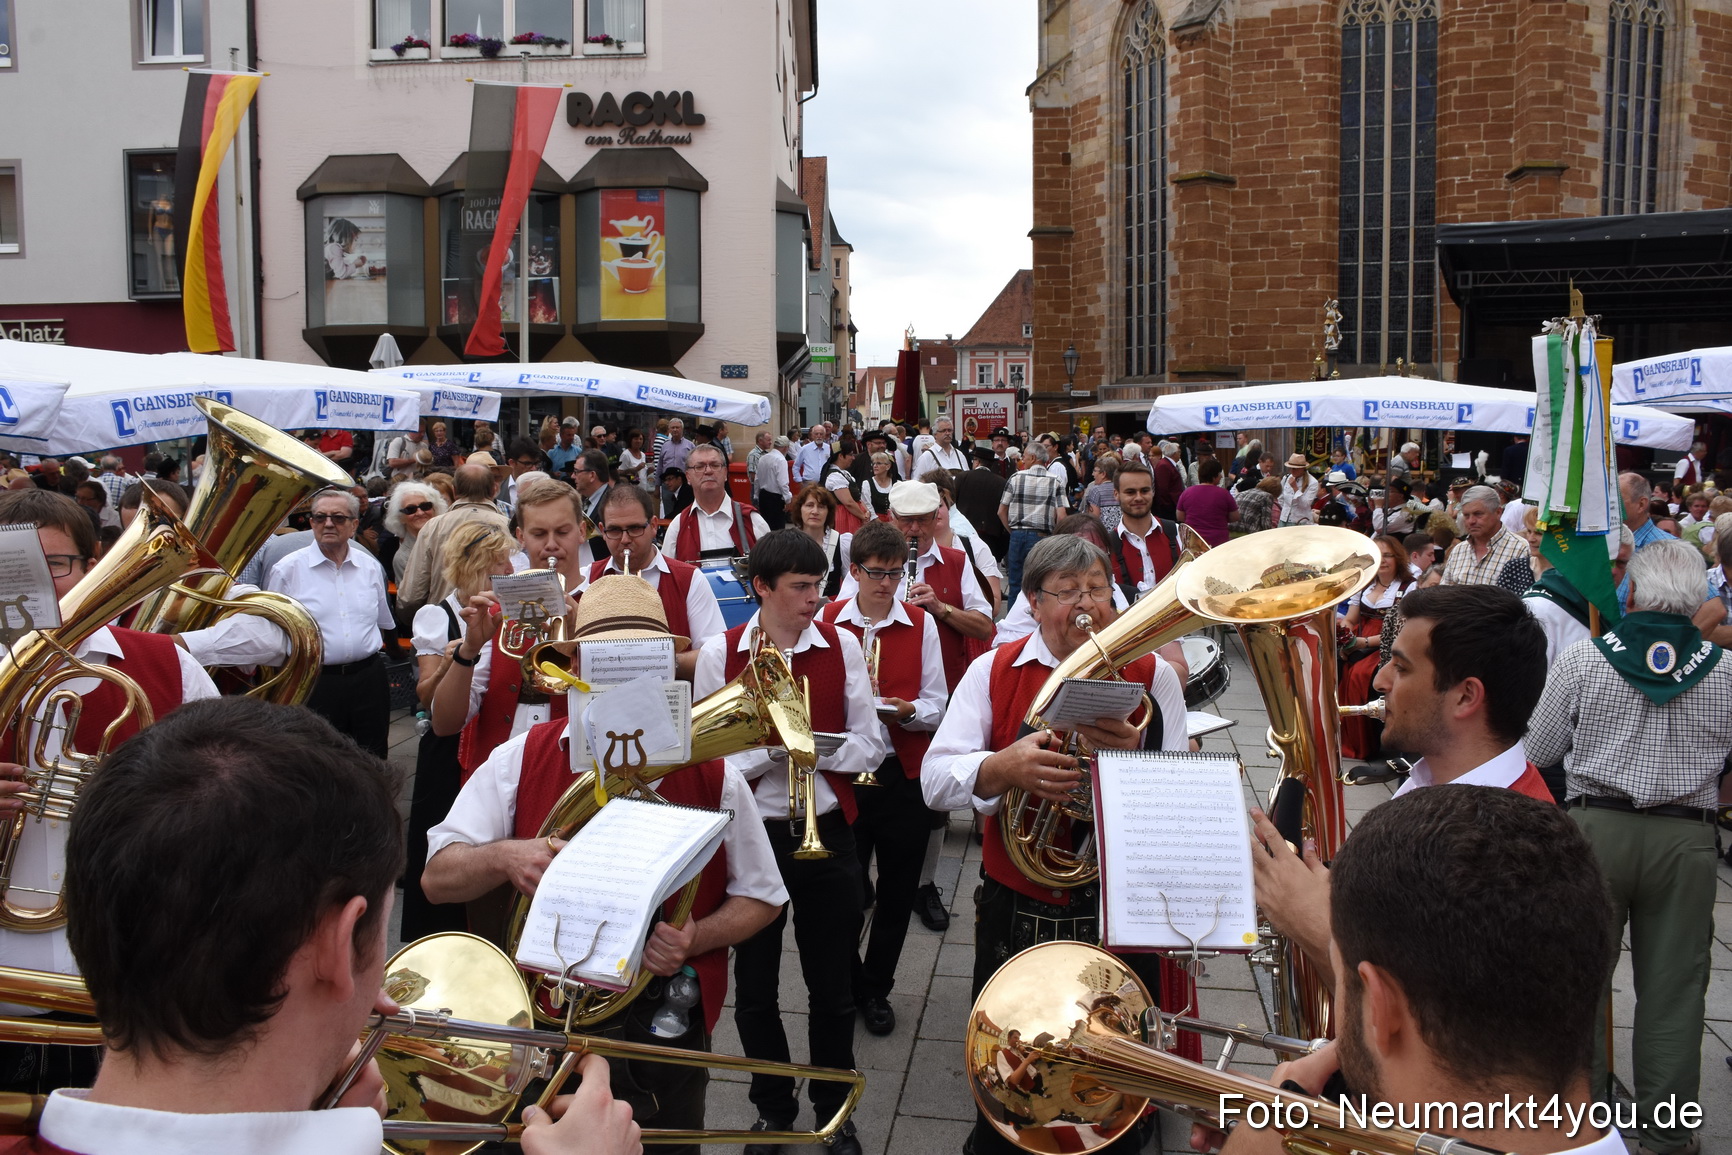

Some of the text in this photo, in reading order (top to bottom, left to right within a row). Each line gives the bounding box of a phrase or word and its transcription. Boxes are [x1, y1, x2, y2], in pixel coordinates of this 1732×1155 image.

[566, 90, 706, 127] RACKL
[584, 126, 692, 146] am Rathaus
[466, 210, 500, 230] RACK
[1602, 631, 1626, 652] WV
